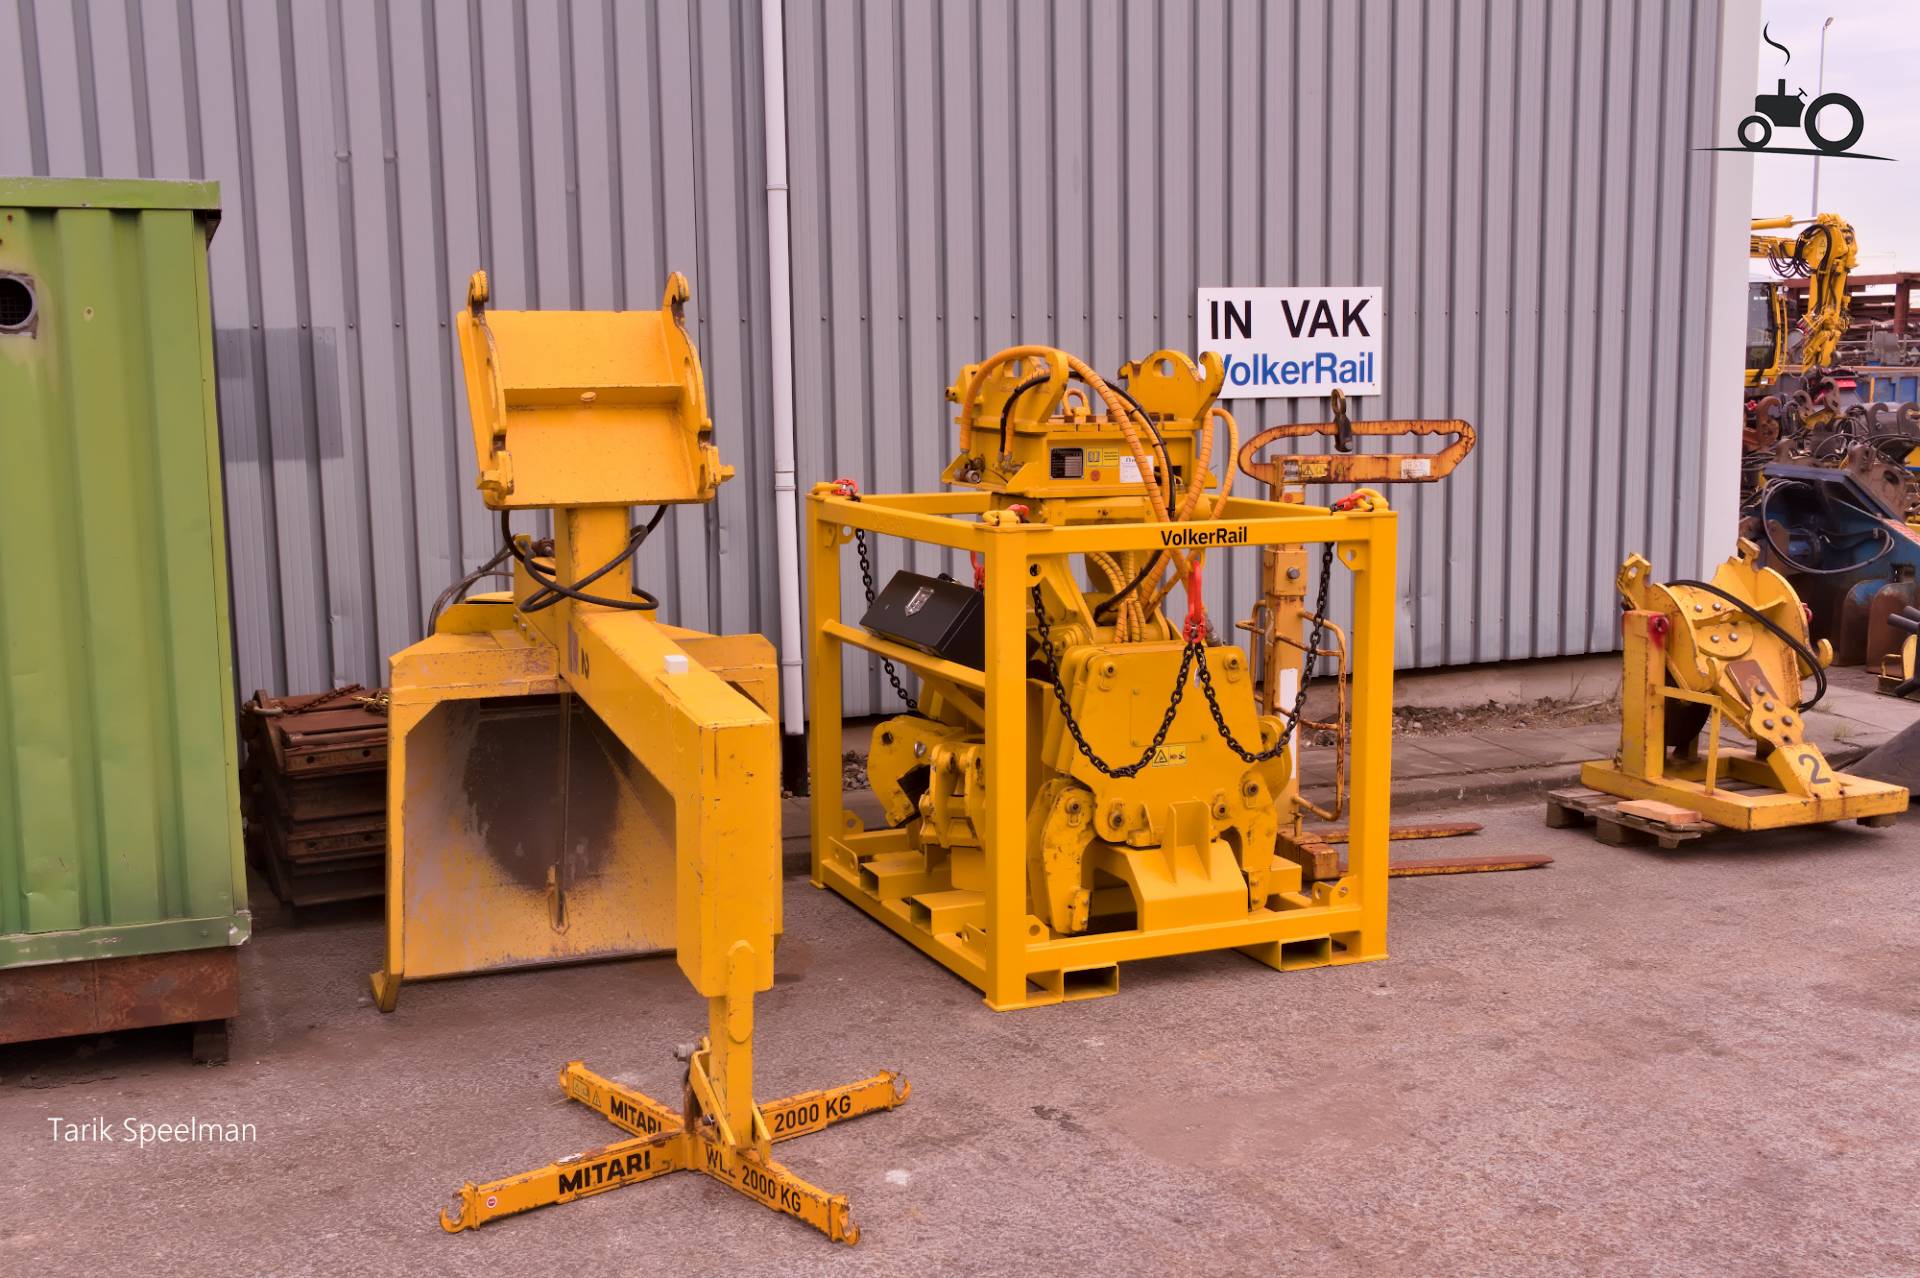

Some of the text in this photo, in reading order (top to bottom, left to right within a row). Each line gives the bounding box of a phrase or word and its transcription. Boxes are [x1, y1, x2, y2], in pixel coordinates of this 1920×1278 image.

[1210, 299, 1371, 340] IN VAK
[1161, 527, 1248, 547] VolkerRail
[1798, 754, 1831, 785] 2
[611, 1095, 662, 1135] MITARI
[774, 1095, 851, 1133] 2000 KG
[558, 1150, 651, 1195] MITARI
[742, 1165, 776, 1200] 2000
[780, 1184, 801, 1213] KG
